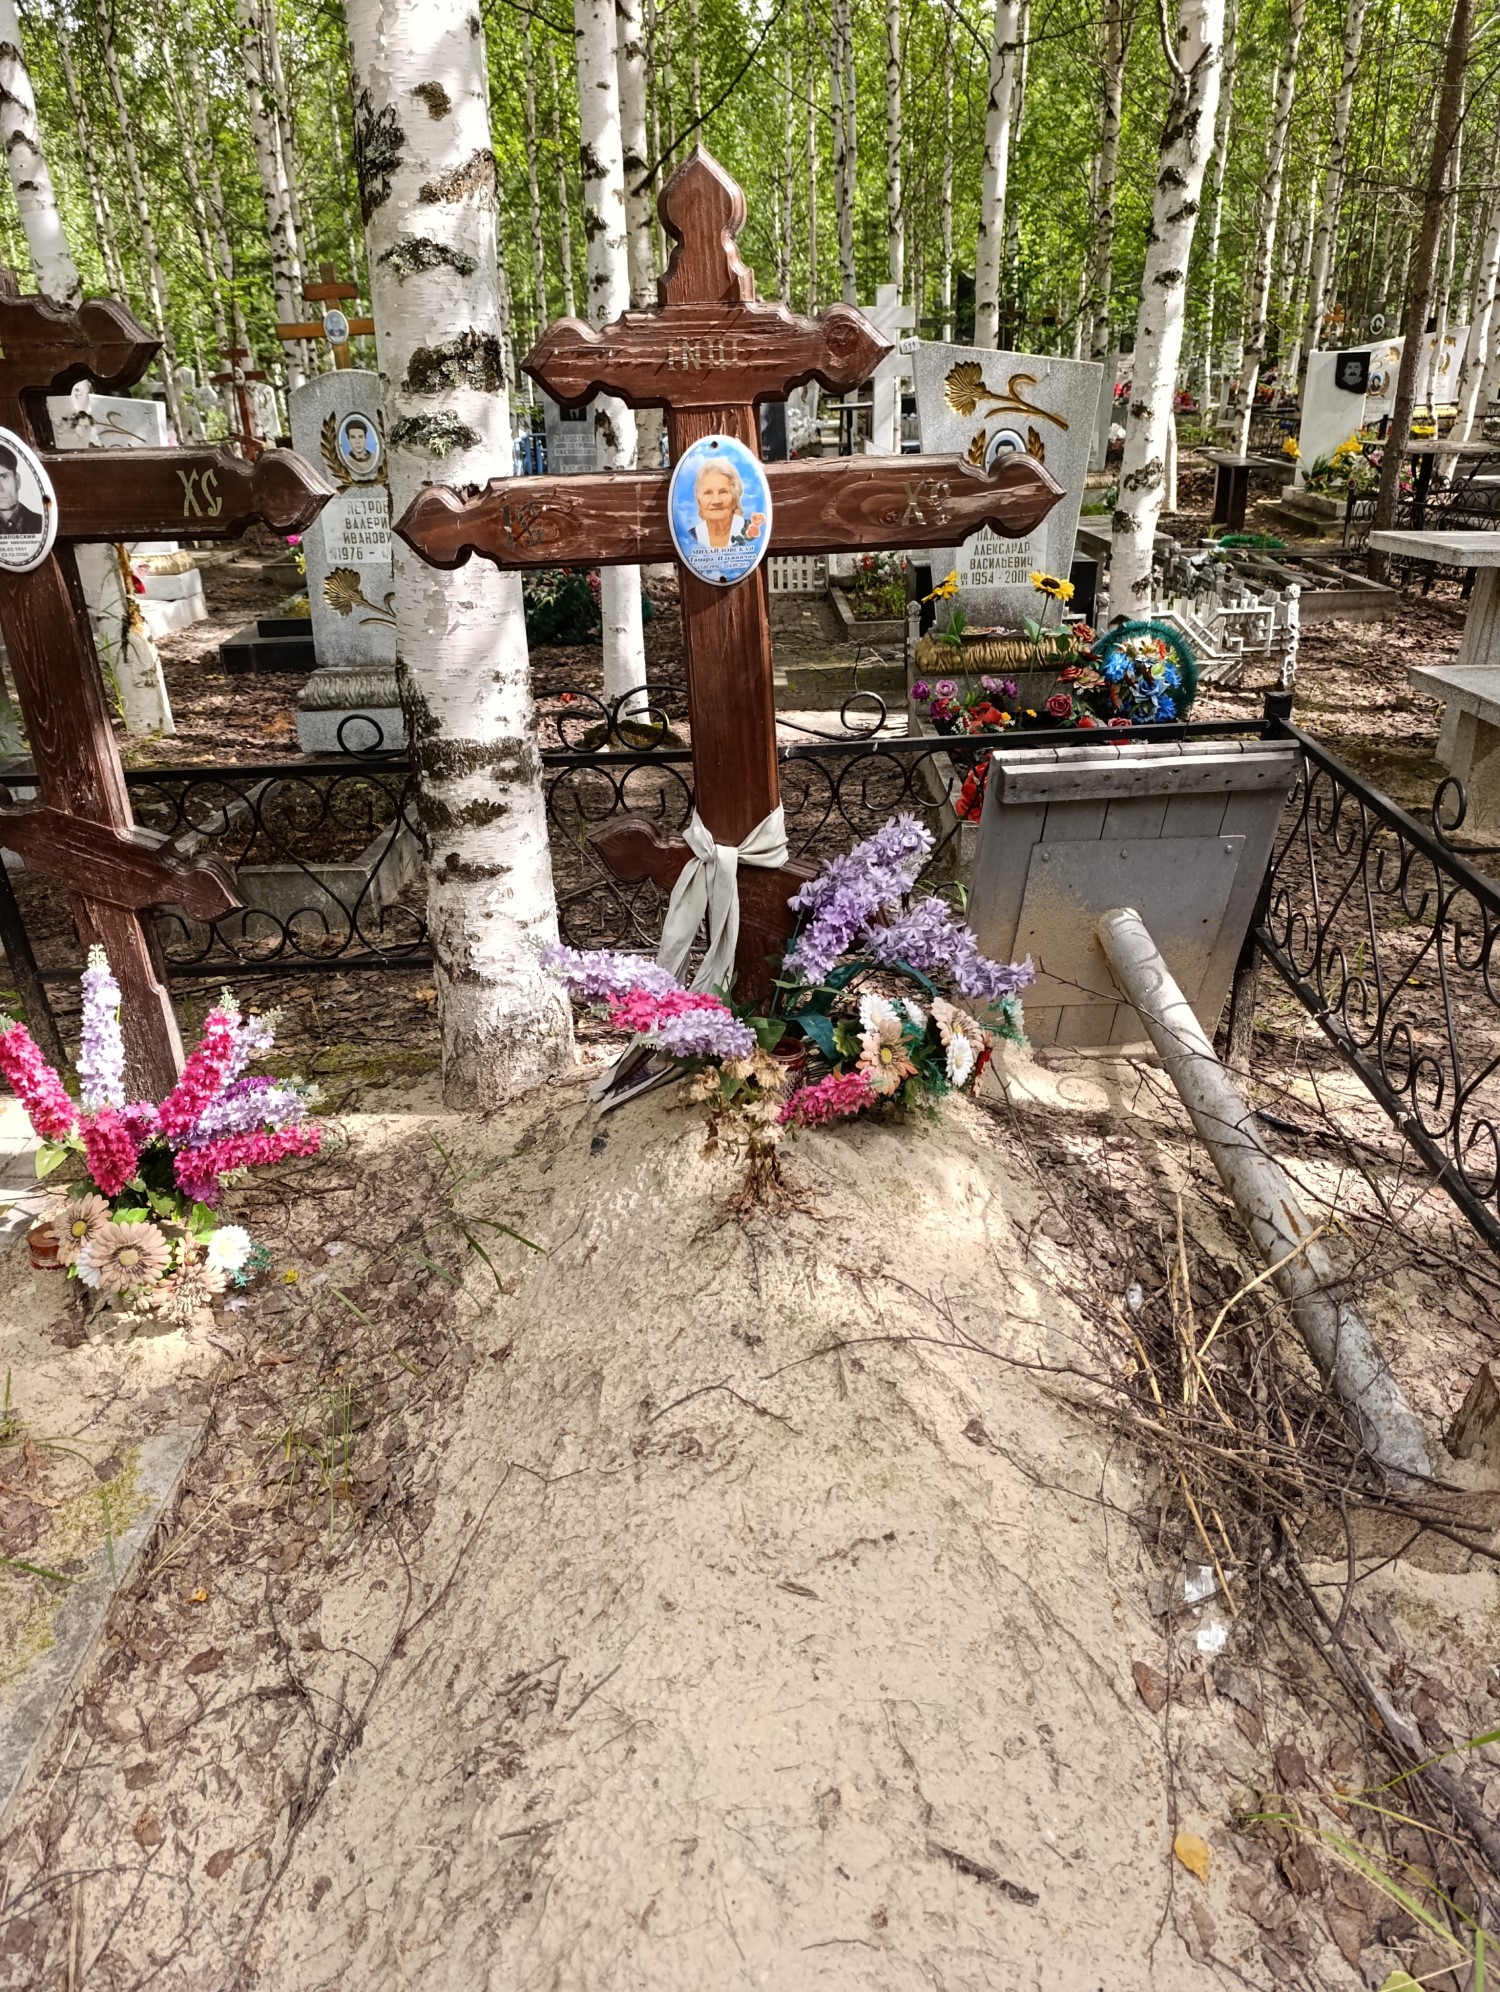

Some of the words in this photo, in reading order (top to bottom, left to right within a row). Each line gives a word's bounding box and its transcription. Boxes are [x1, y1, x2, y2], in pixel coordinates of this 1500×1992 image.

[973, 541, 1031, 556] АЛЕКСАНДР
[970, 556, 1034, 570] ВАСИЛЬЕВИЧ
[971, 571, 994, 585] 1954
[1005, 570, 1027, 583] 2001
